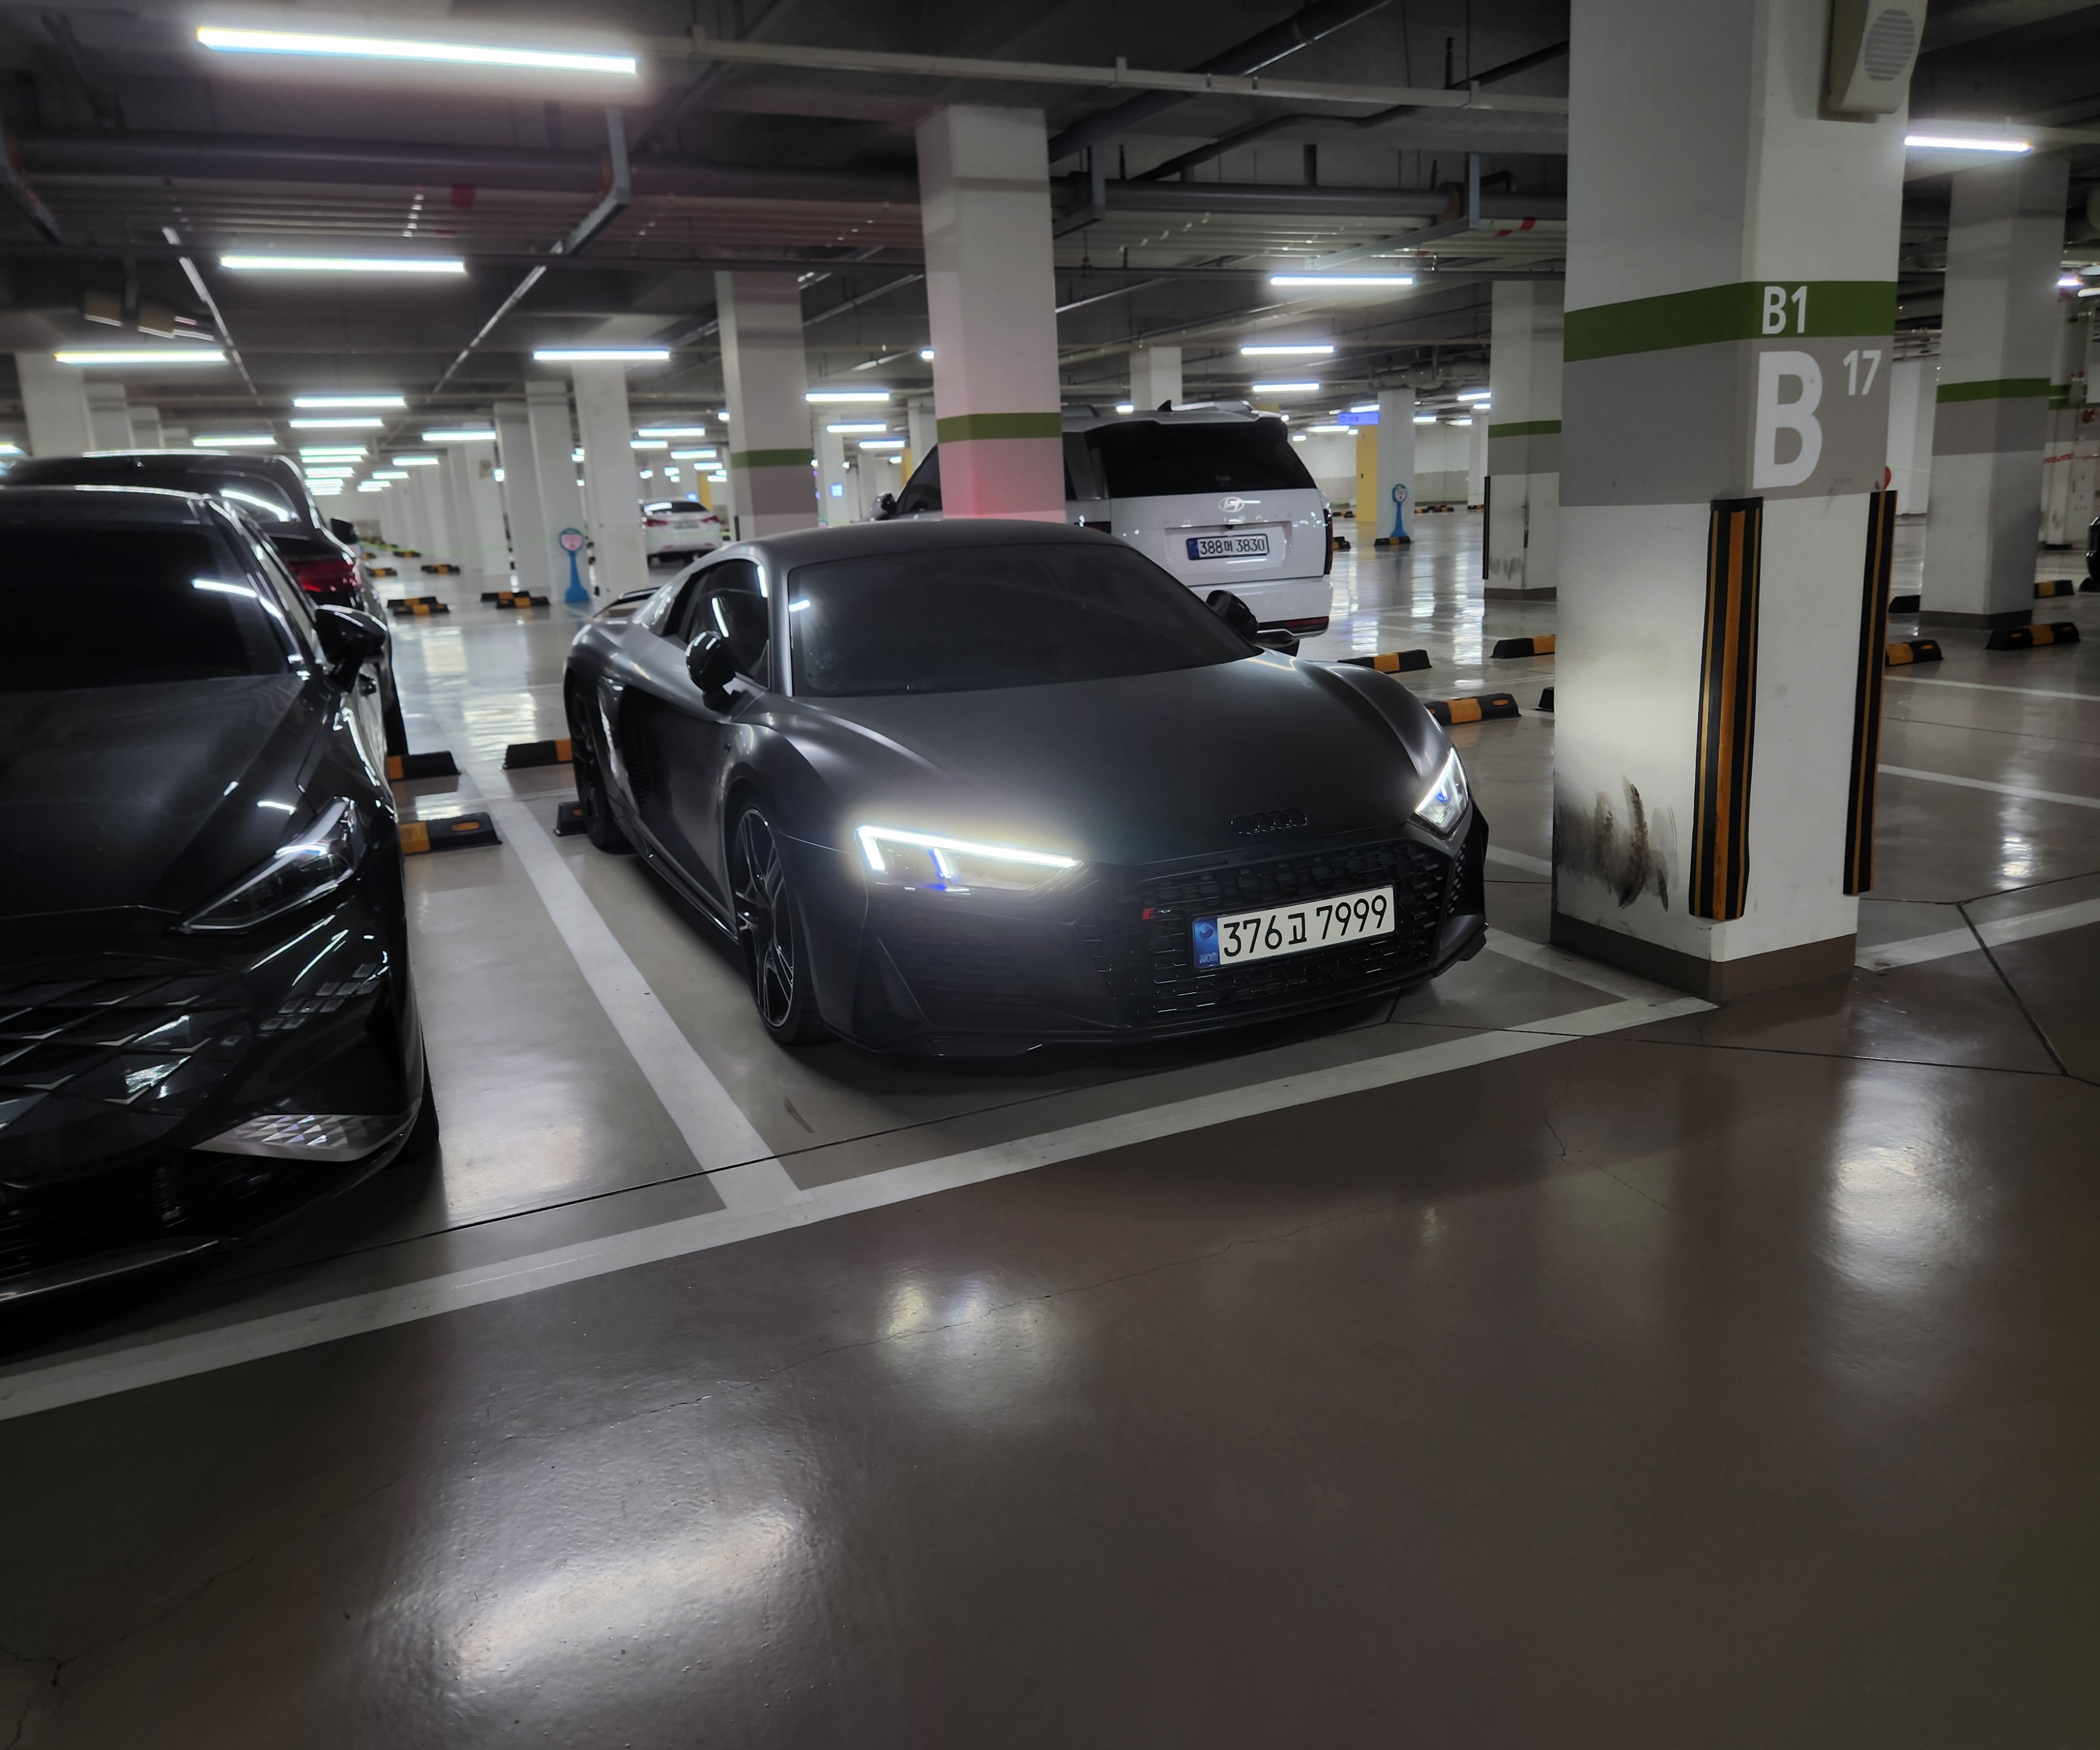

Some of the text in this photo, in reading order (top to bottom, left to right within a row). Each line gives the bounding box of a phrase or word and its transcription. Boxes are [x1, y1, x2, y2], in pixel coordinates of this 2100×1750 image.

[1762, 286, 1807, 334] B1
[1753, 350, 1881, 489] B 17
[1235, 538, 1265, 552] 3830
[1223, 894, 1387, 957] 376고 7999
